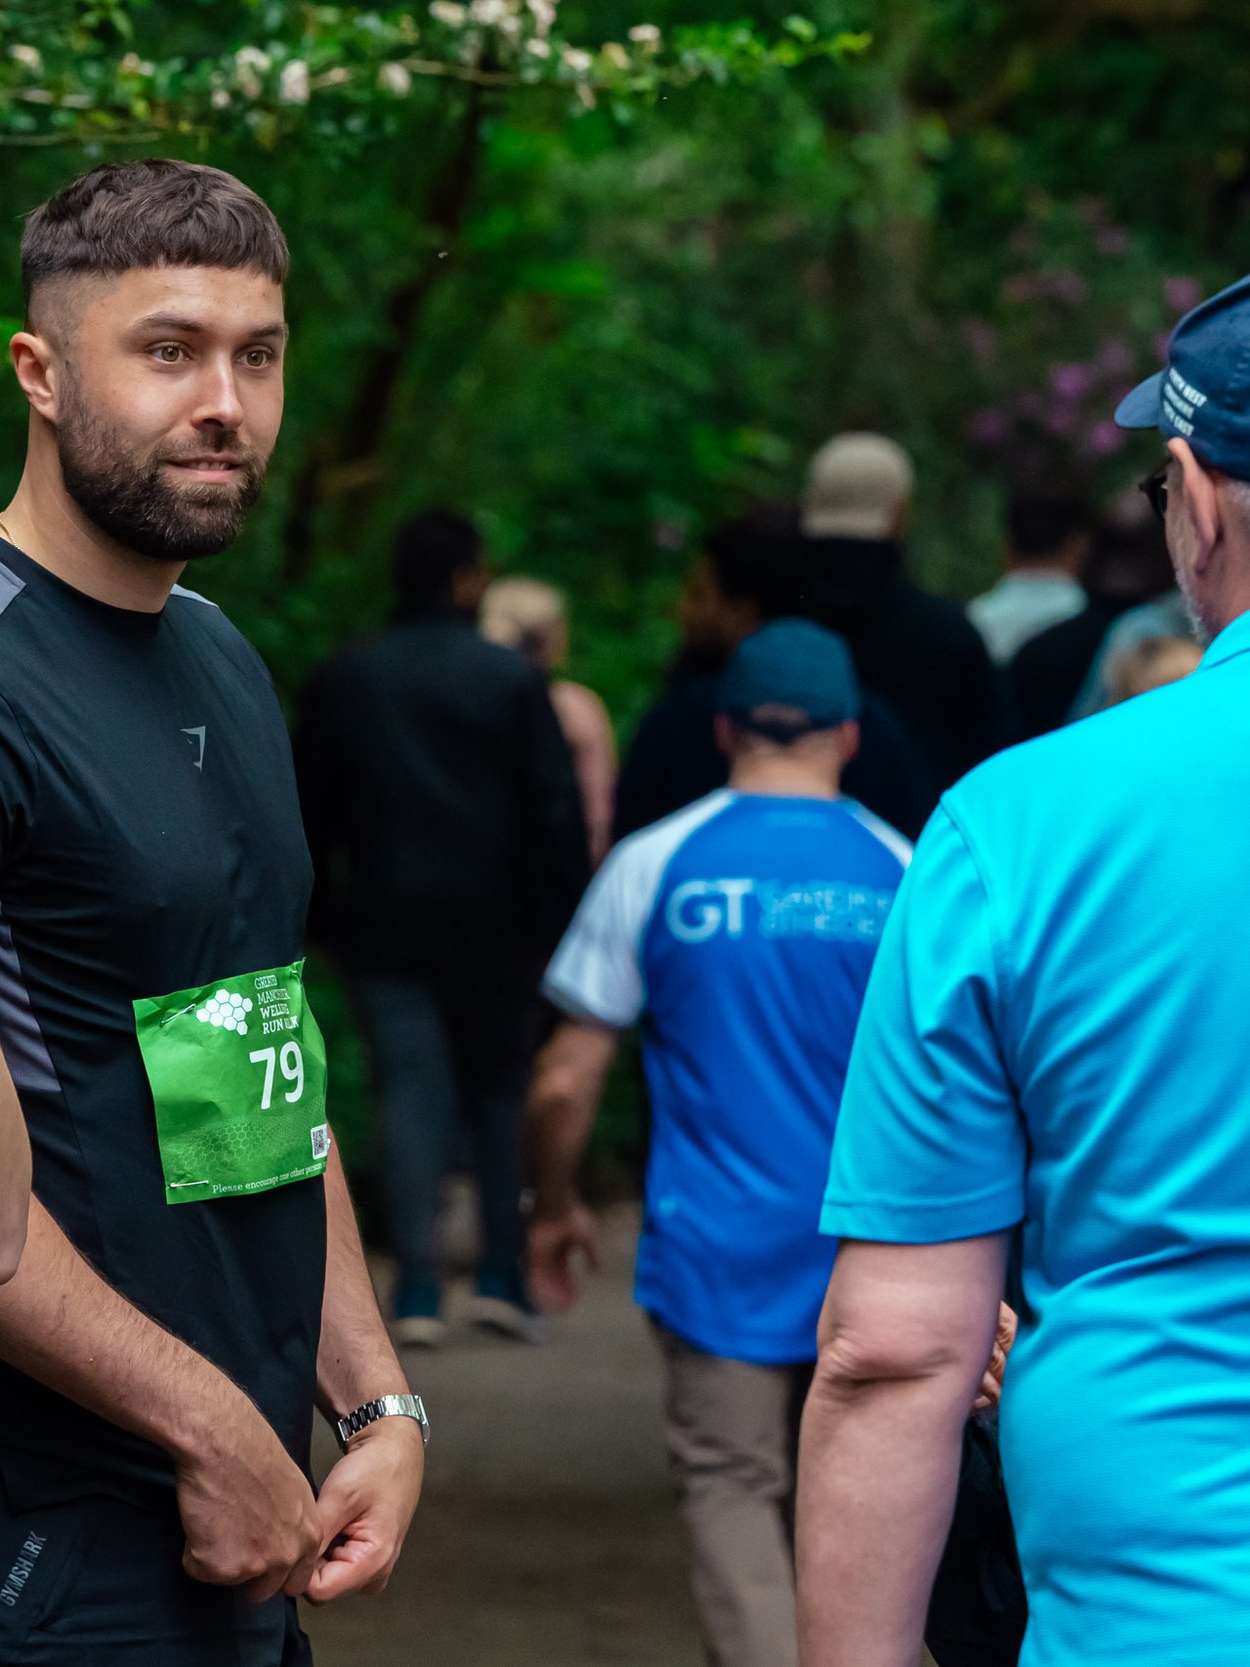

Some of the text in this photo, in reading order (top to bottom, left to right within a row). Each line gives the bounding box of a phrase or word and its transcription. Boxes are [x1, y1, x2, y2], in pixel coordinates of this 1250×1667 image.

[666, 879, 754, 943] GT
[262, 1018, 283, 1034] RUN
[249, 1041, 305, 1110] 79
[212, 1183, 243, 1193] Please
